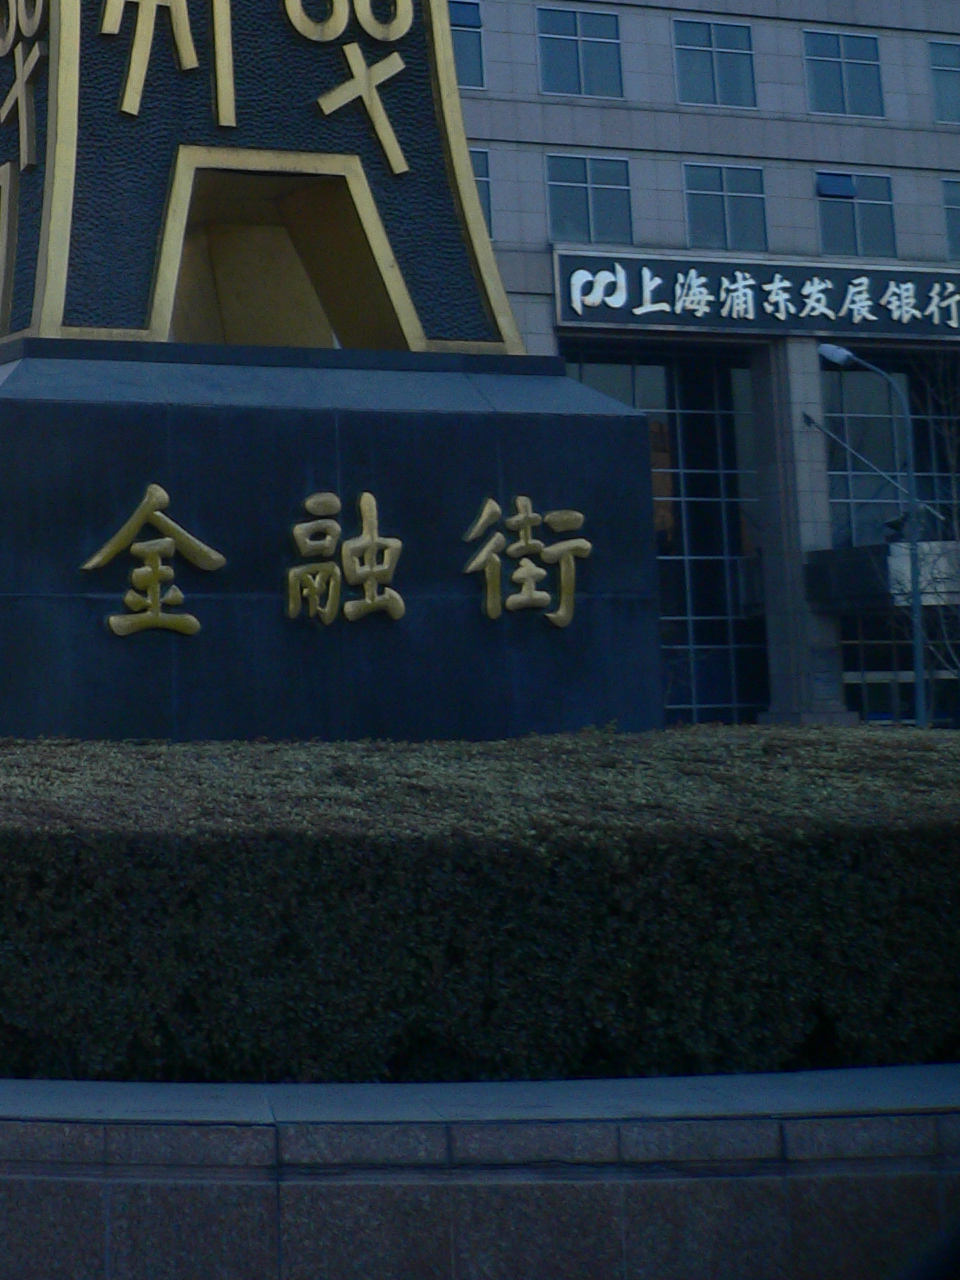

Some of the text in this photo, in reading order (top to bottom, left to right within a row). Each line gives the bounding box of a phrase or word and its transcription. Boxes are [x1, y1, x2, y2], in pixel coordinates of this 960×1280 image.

[632, 267, 960, 329] 上海浦东发展银行
[80, 483, 594, 637] 金融街
